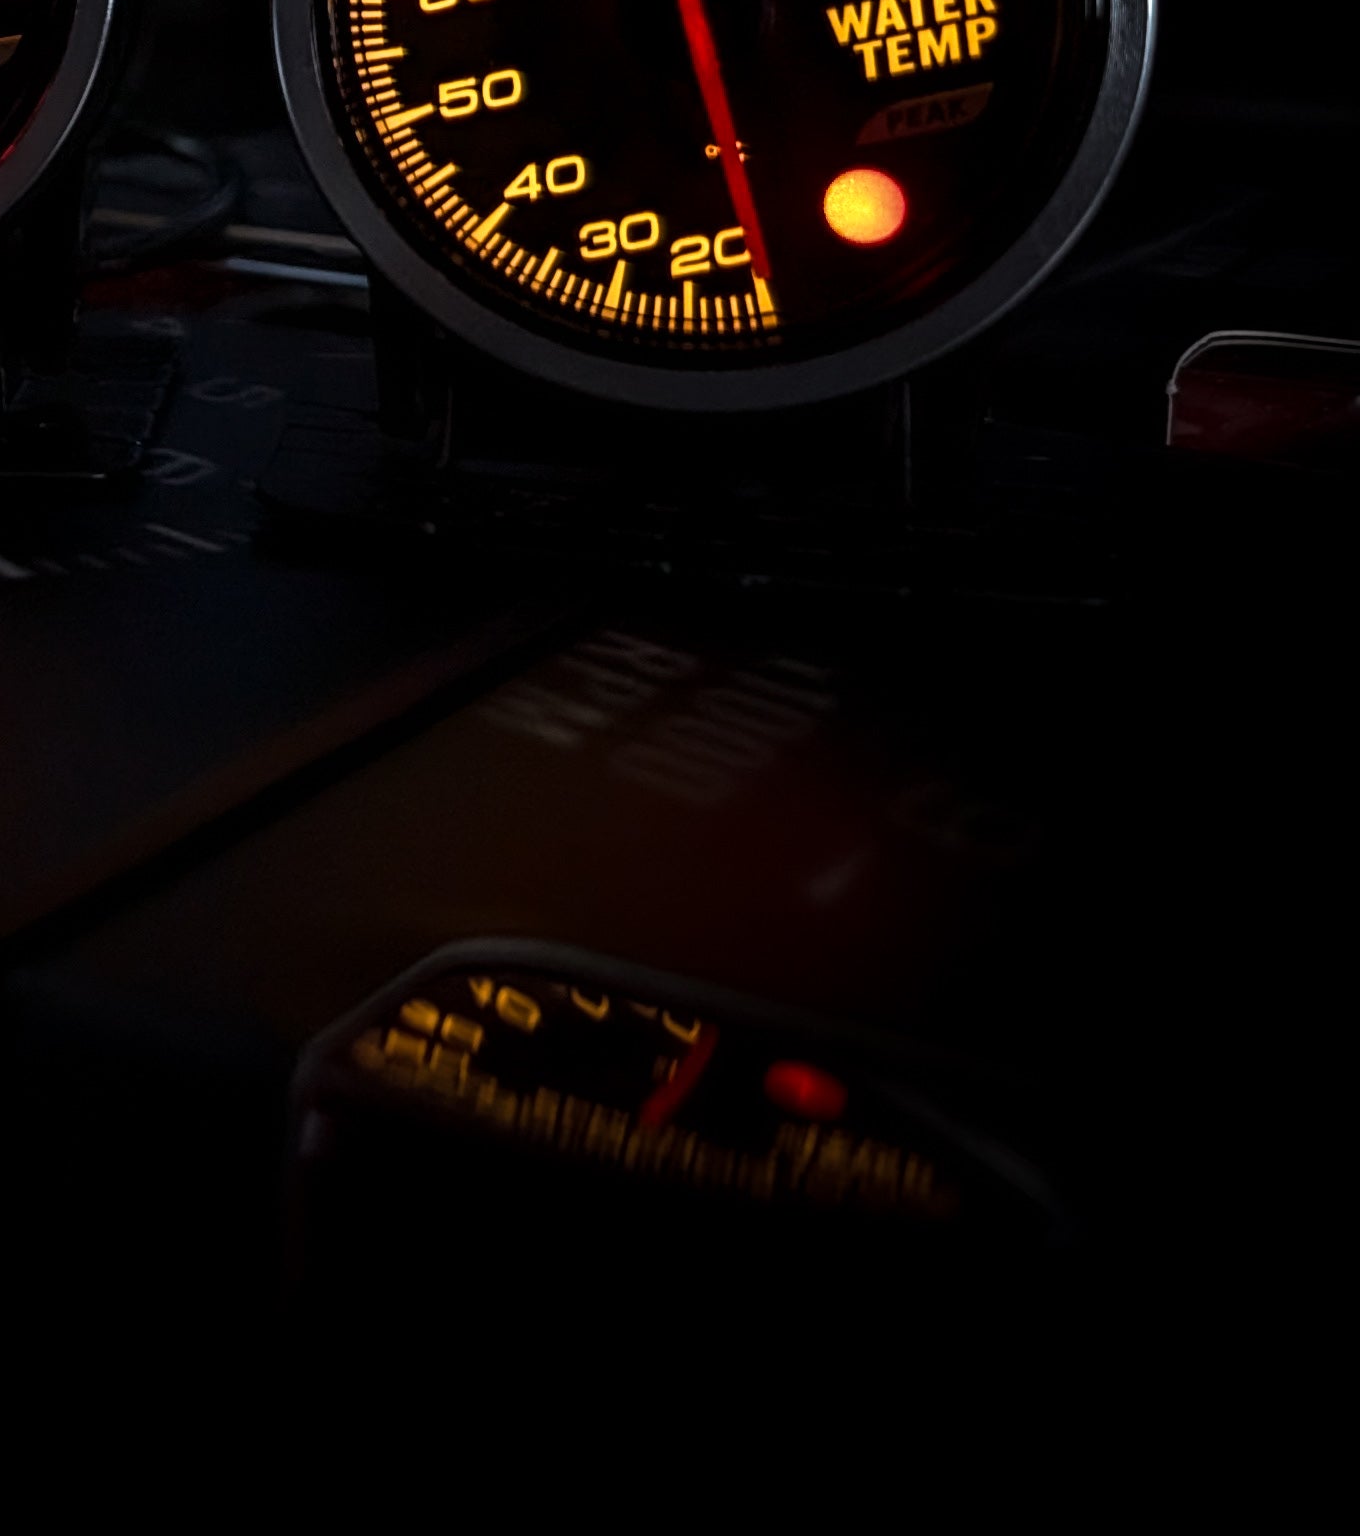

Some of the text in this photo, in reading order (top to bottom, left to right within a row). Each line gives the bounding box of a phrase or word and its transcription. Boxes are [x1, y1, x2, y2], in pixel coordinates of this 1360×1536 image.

[854, 15, 999, 81] TEMP
[437, 70, 524, 118] 50
[503, 155, 587, 202] 40
[578, 212, 661, 260] 30
[671, 226, 752, 278] 20
